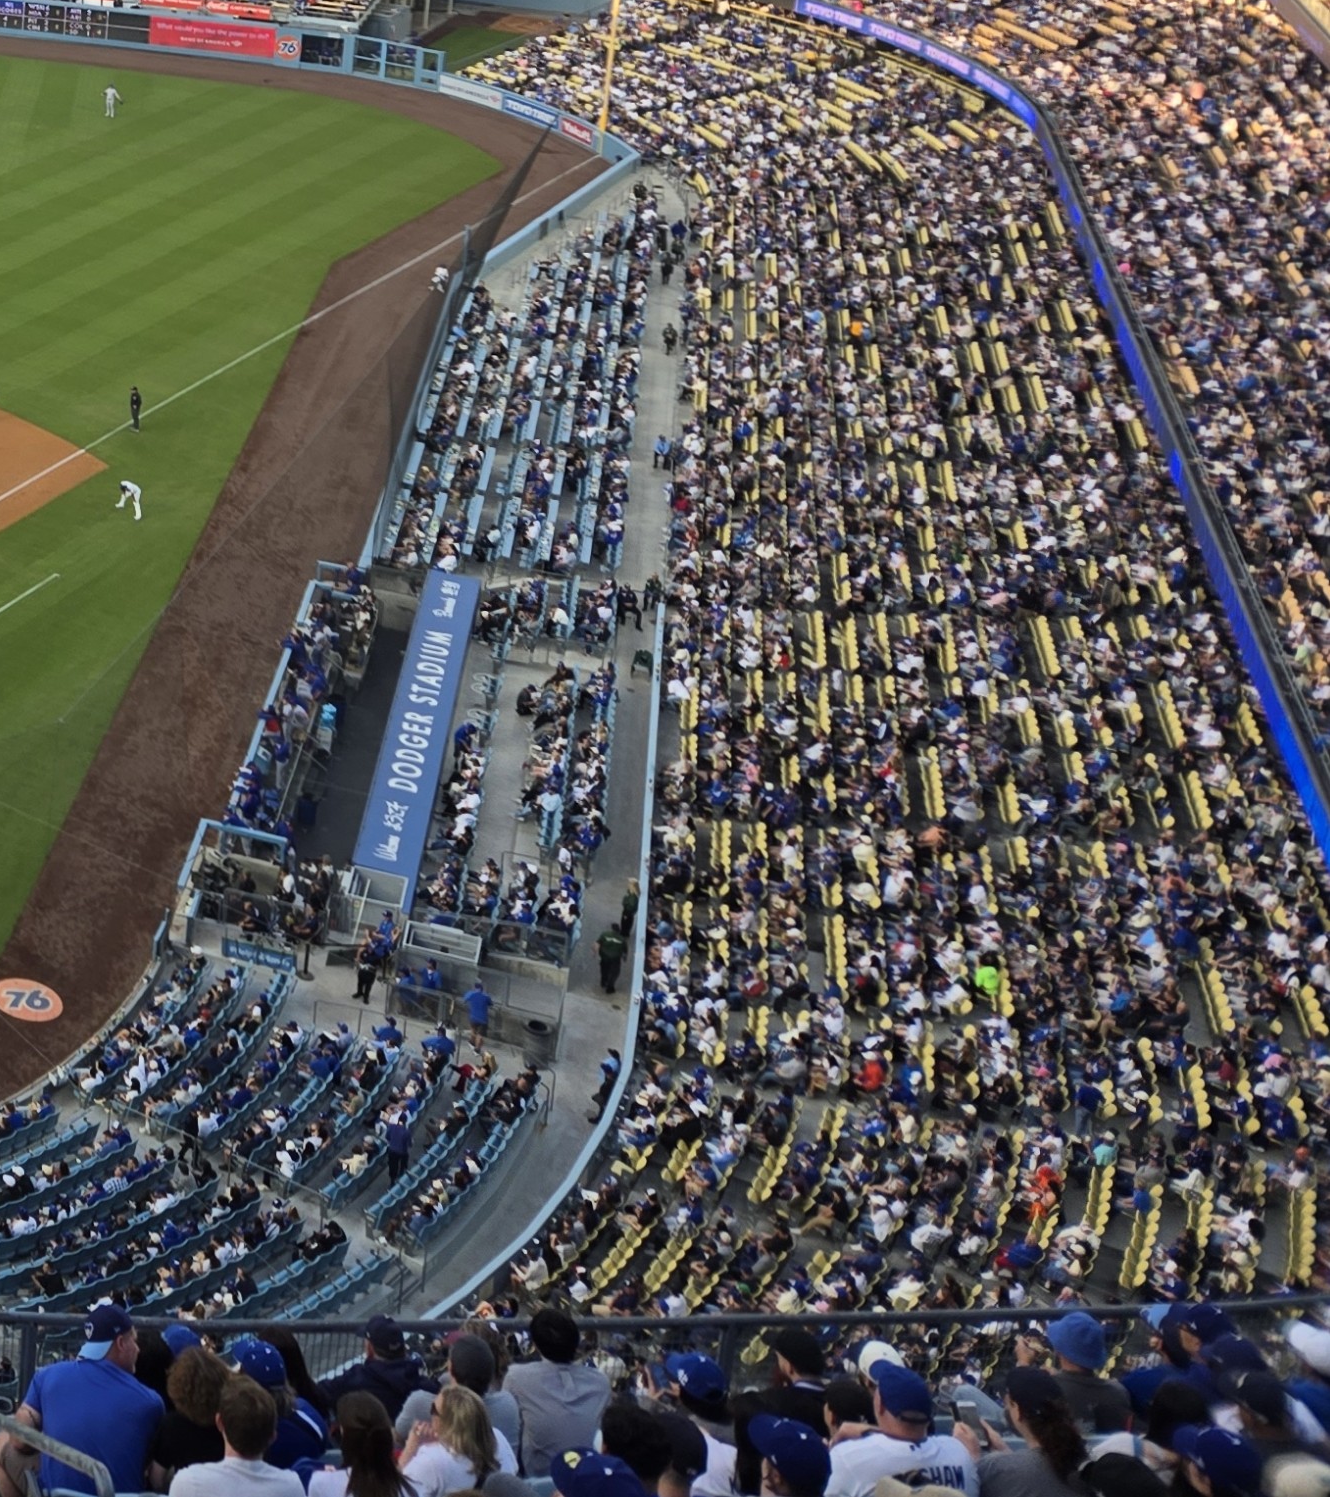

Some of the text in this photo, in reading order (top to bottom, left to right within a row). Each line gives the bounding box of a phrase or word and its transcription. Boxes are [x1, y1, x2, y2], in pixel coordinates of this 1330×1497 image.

[281, 42, 297, 54] 76
[409, 630, 453, 707] STADIUM
[388, 711, 434, 794] DODGER
[4, 989, 52, 1011] 76
